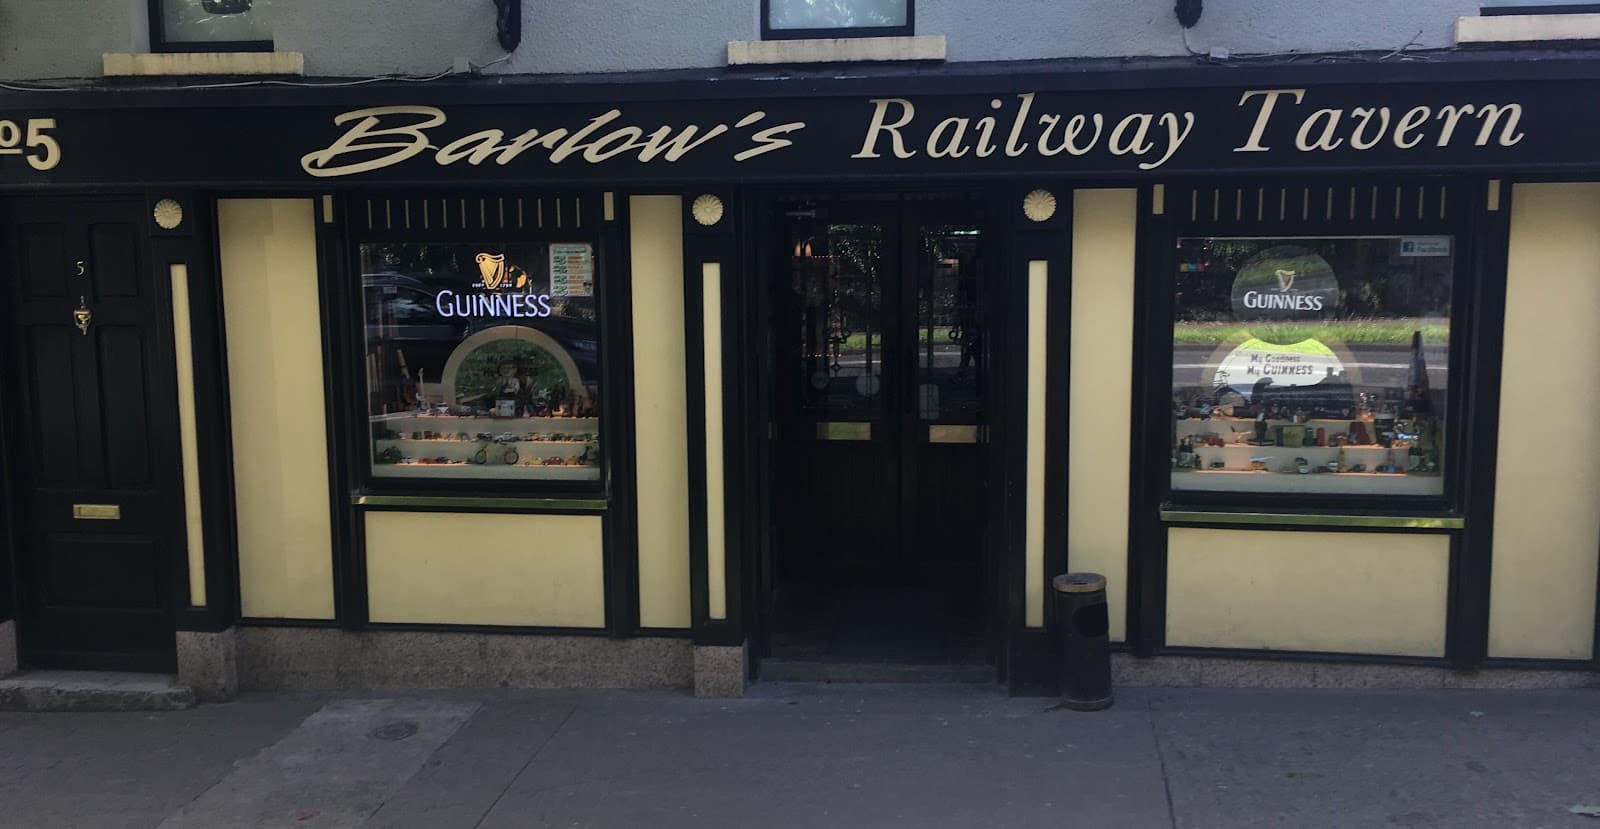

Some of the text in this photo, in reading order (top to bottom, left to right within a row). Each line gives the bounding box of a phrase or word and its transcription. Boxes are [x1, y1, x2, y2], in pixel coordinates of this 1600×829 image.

[300, 89, 1525, 177] Barlow's Railway Tavern
[76, 260, 85, 276] 5
[435, 289, 552, 318] GUINNESS
[1243, 290, 1325, 311] GUINNESS
